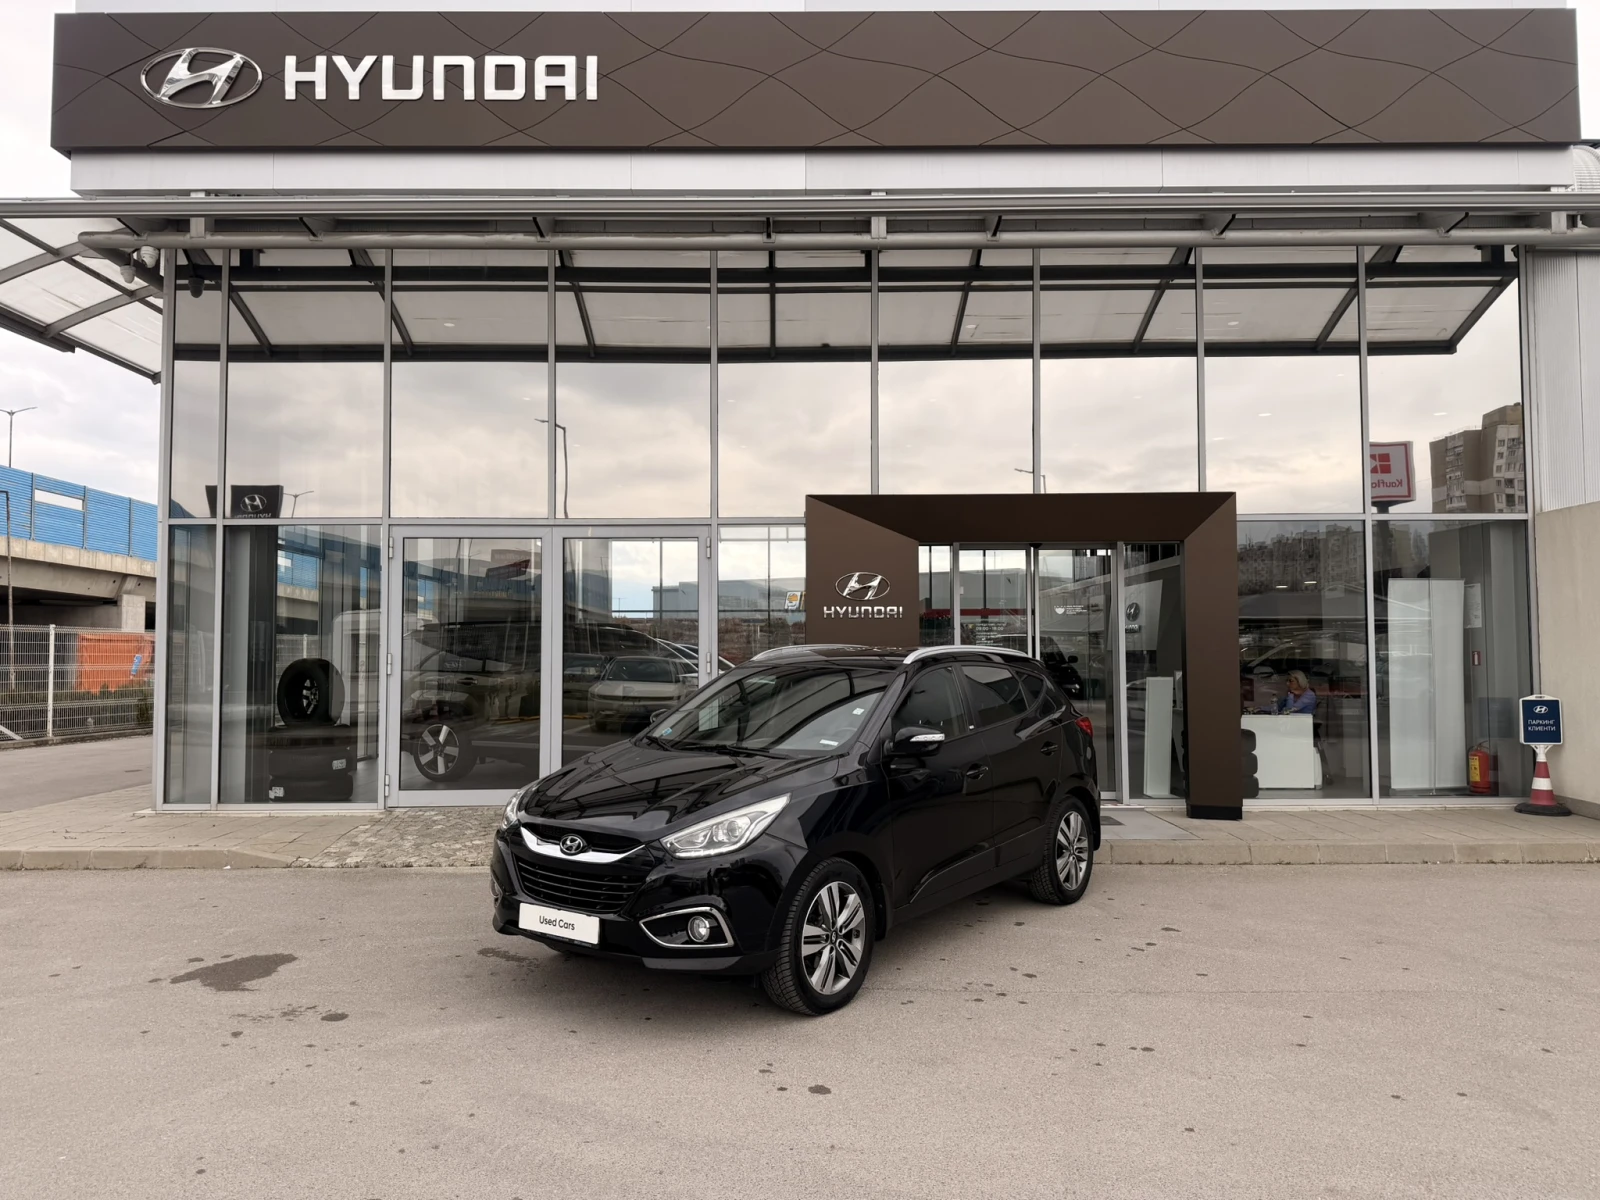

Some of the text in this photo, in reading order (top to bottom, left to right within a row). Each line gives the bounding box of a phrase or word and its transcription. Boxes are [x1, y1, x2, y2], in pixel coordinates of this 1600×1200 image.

[284, 55, 598, 101] HYUNDAI
[823, 606, 903, 619] HYUNDAI
[539, 915, 575, 930] Used Cars
